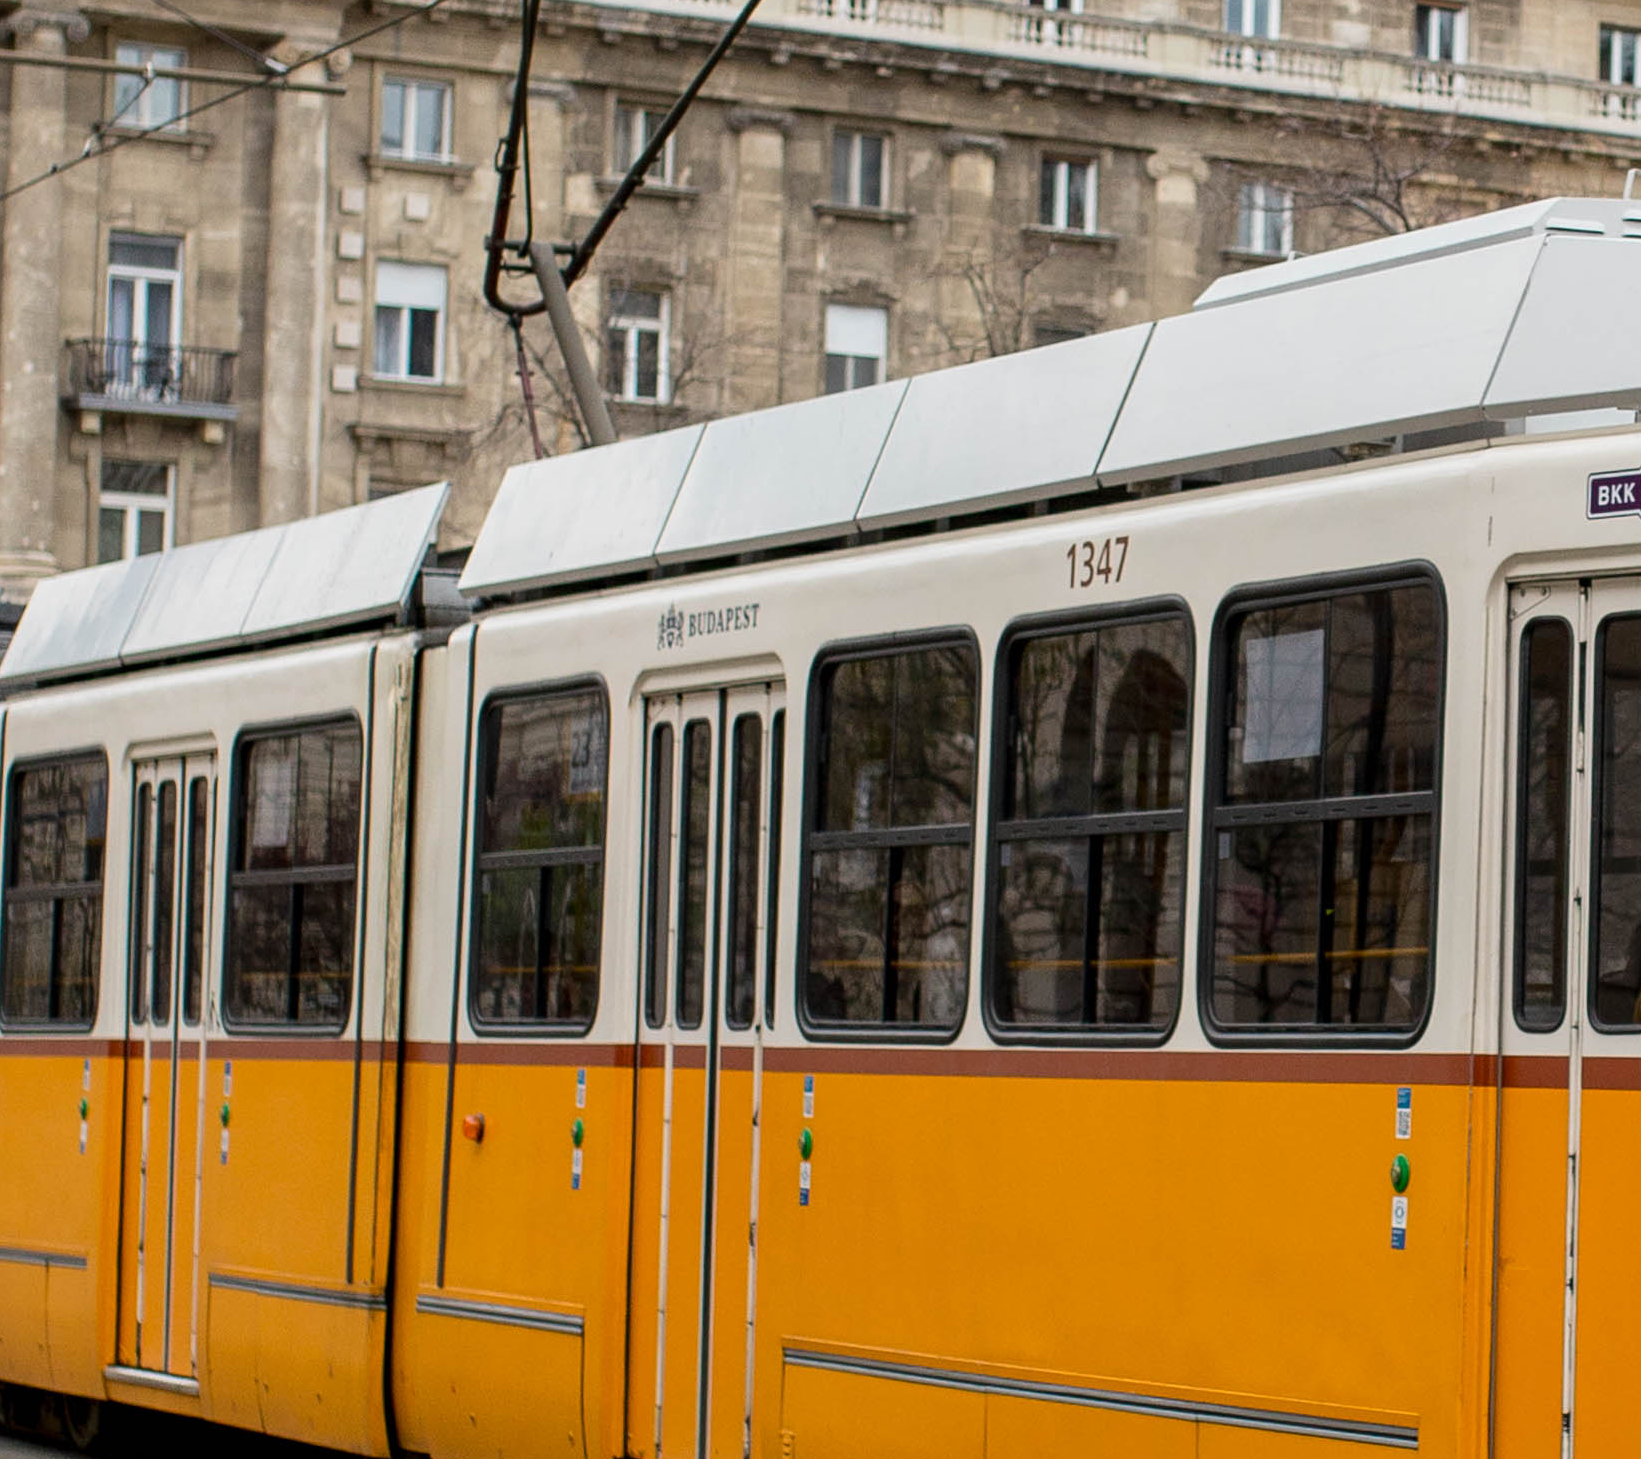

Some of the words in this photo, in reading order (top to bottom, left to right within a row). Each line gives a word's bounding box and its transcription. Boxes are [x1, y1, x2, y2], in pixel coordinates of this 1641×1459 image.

[1598, 482, 1636, 506] BKK
[1067, 535, 1130, 589] 1347
[688, 603, 760, 637] BUDAPEST
